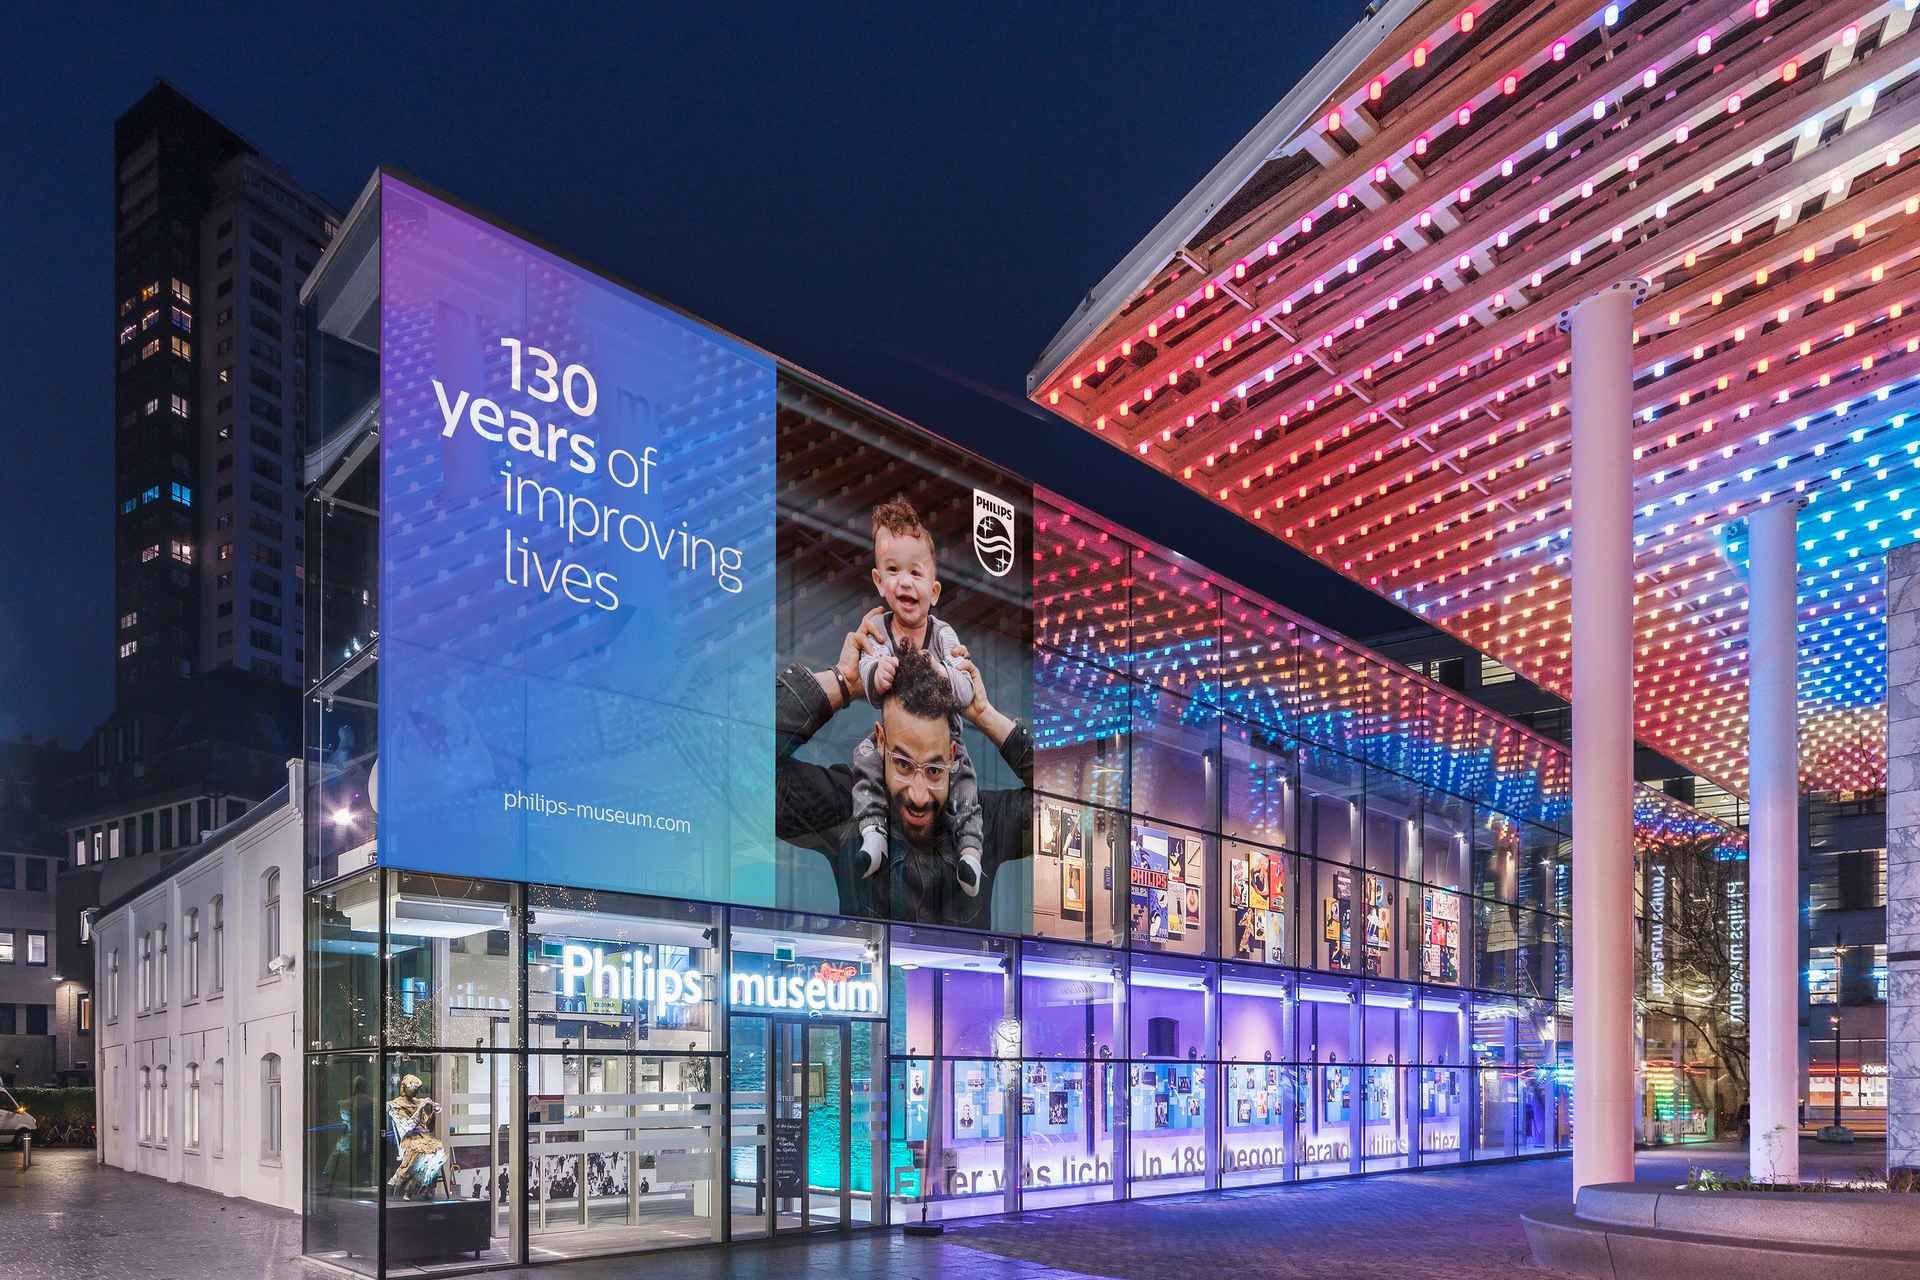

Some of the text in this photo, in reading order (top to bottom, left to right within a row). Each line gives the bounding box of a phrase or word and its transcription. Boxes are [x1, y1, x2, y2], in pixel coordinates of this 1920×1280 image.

[500, 337, 598, 417] 130
[432, 379, 658, 495] years of
[501, 461, 743, 594] improving
[976, 496, 1012, 520] PHILIPS
[505, 528, 620, 612] lives
[504, 790, 691, 833] philips-museum.com
[1131, 869, 1168, 889] PHILIPS
[563, 945, 878, 1017] Philips museum
[1062, 1154, 1114, 1186] lich
